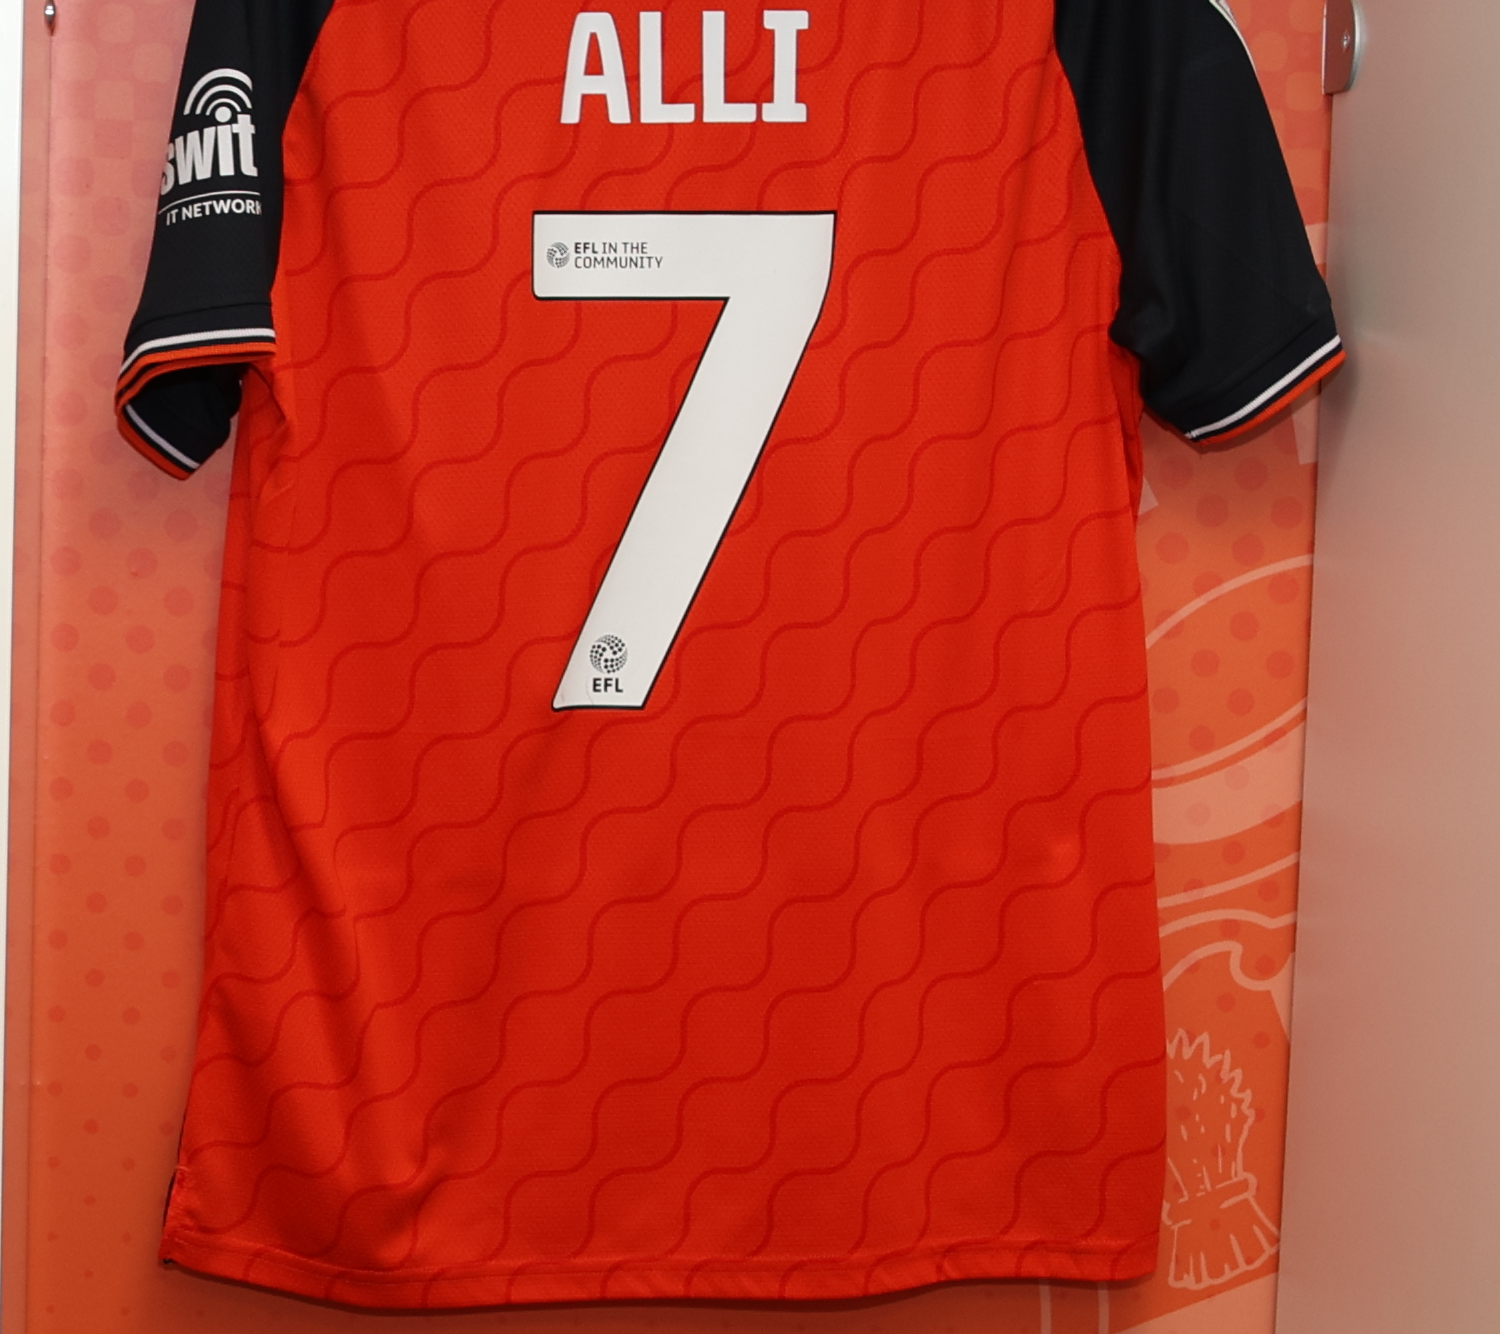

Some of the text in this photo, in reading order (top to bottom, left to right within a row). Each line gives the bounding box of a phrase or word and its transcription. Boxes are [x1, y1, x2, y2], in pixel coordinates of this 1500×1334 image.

[560, 9, 809, 125] ALLI
[166, 208, 178, 226] IT
[574, 242, 648, 255] EFL IN THE
[574, 256, 664, 269] COMMUNITY
[532, 210, 837, 713] 7
[592, 677, 624, 693] EFL
